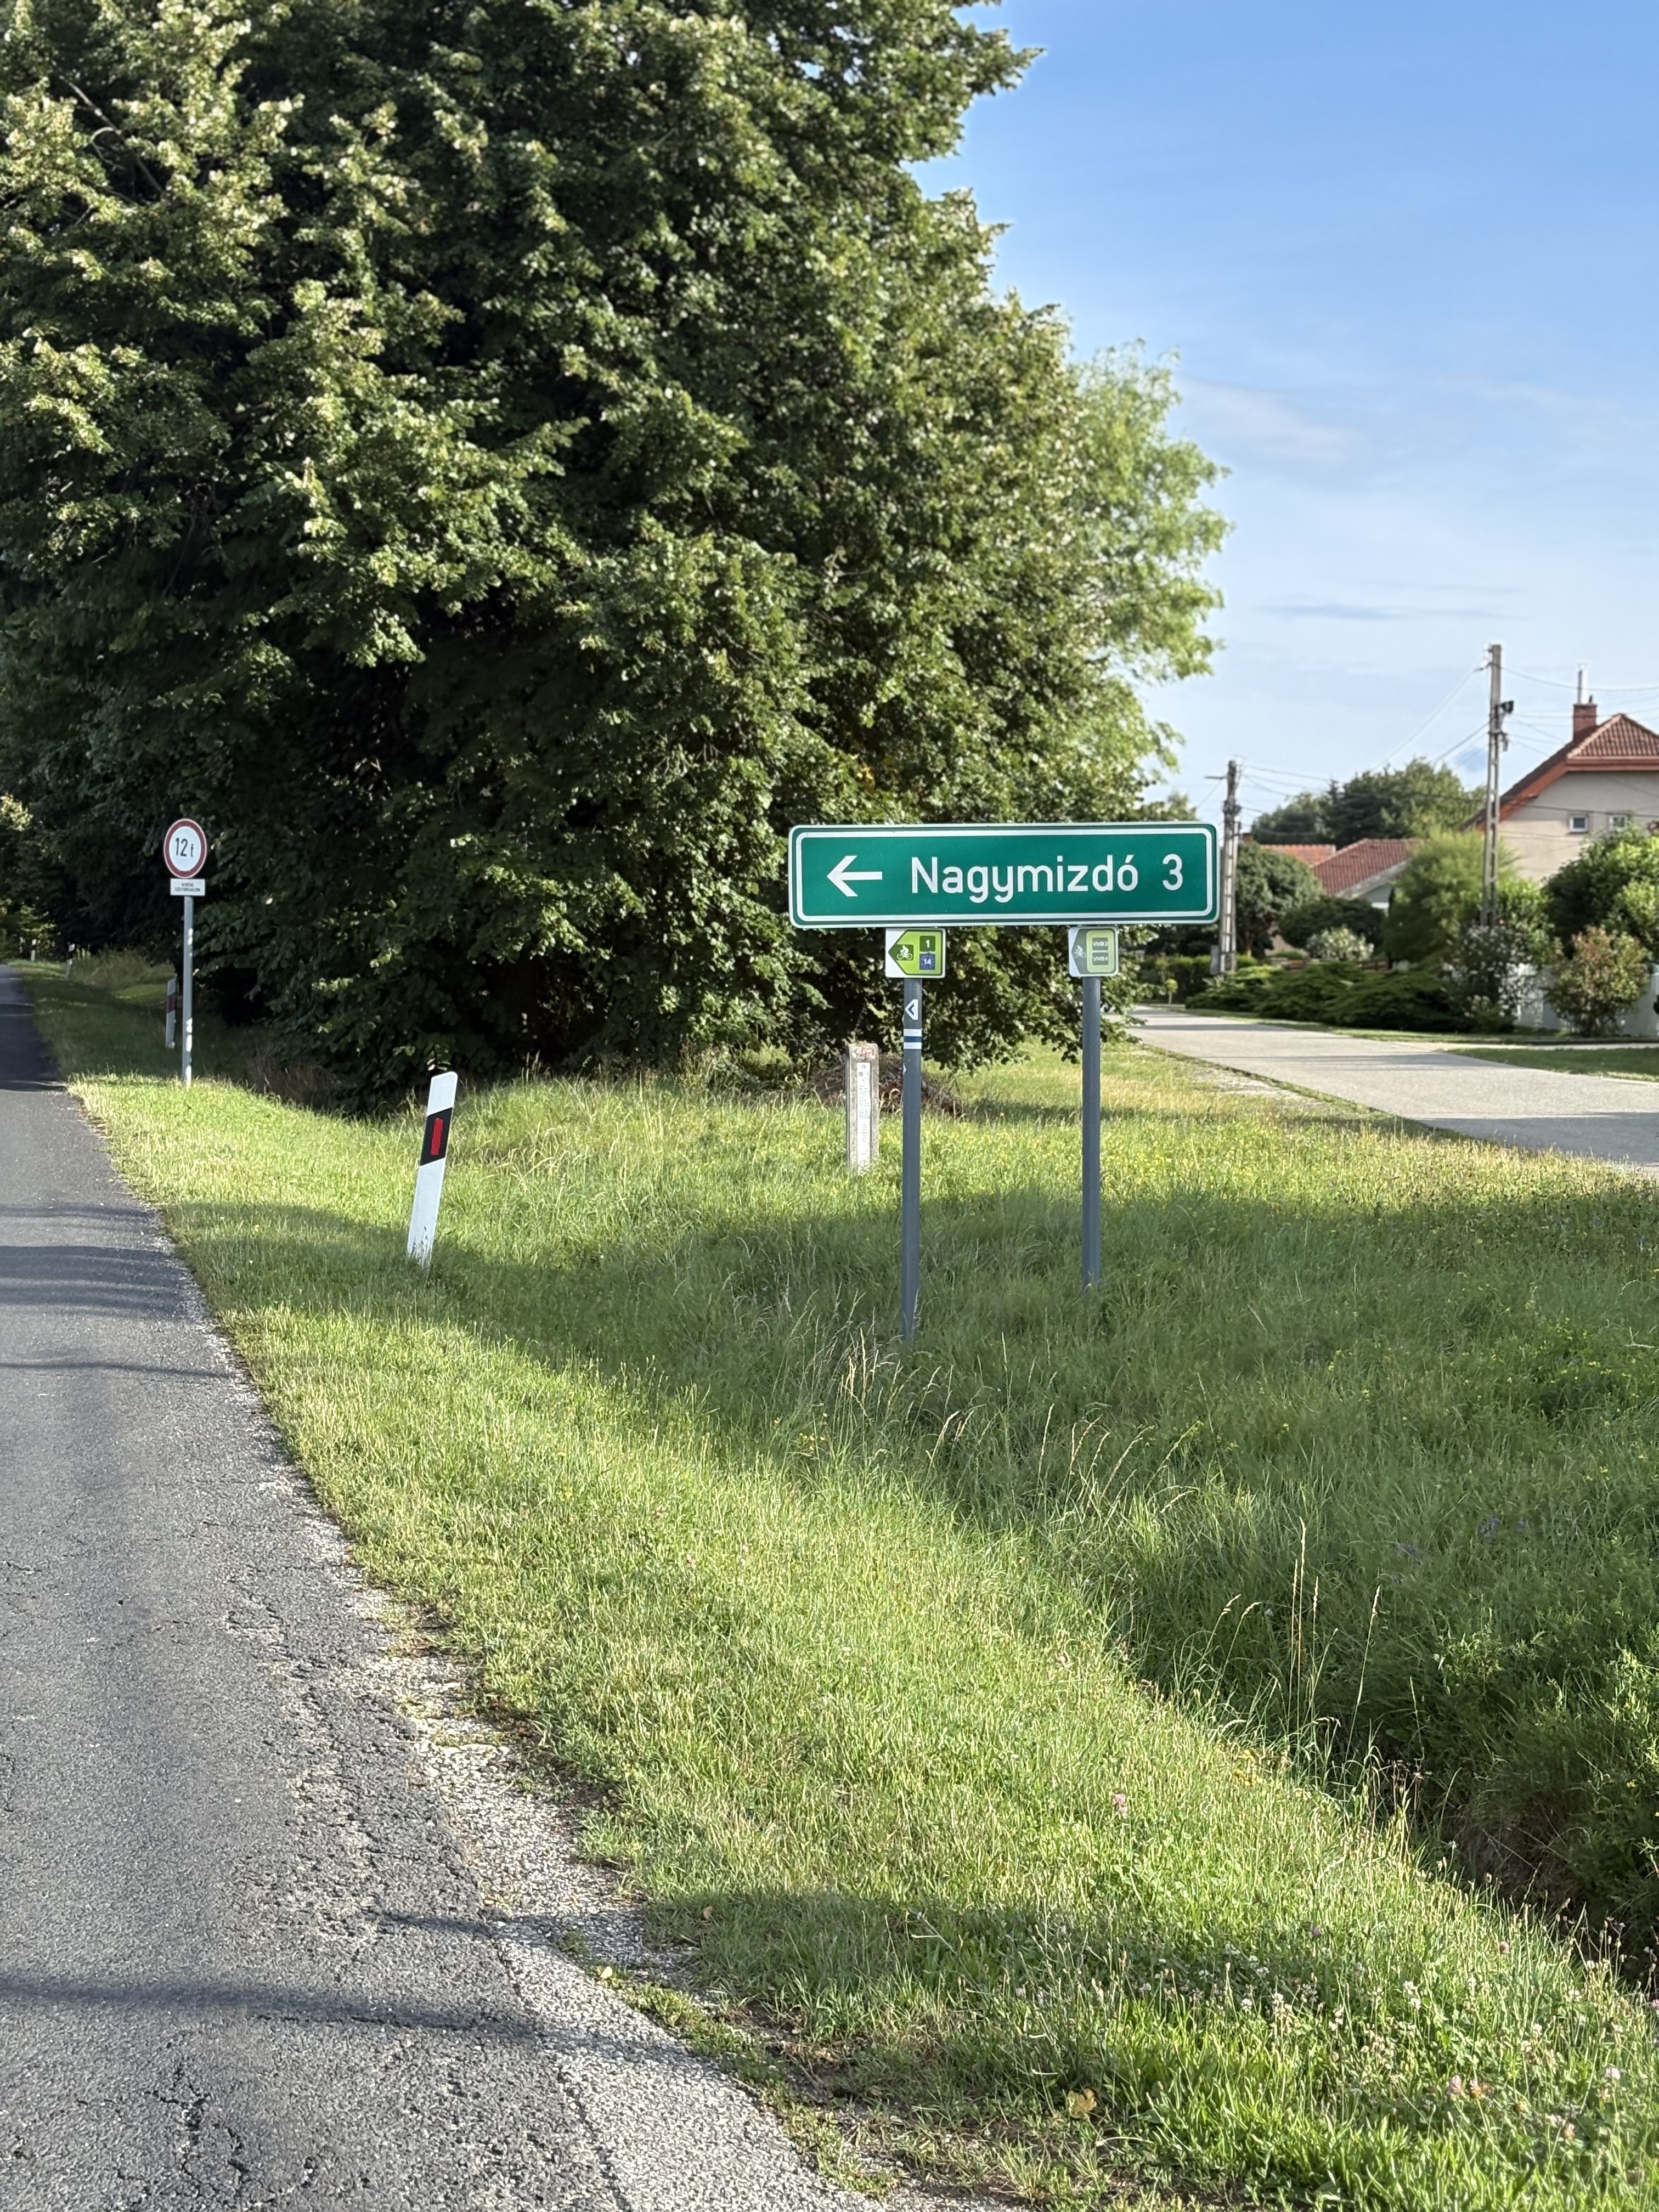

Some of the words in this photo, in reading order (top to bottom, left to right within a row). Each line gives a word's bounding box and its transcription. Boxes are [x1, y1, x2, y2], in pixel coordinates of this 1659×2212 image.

[176, 838, 188, 857] 12
[190, 843, 194, 857] t
[911, 854, 1138, 904] Nagymizdó
[1162, 854, 1183, 891] 3
[926, 940, 929, 948] 1
